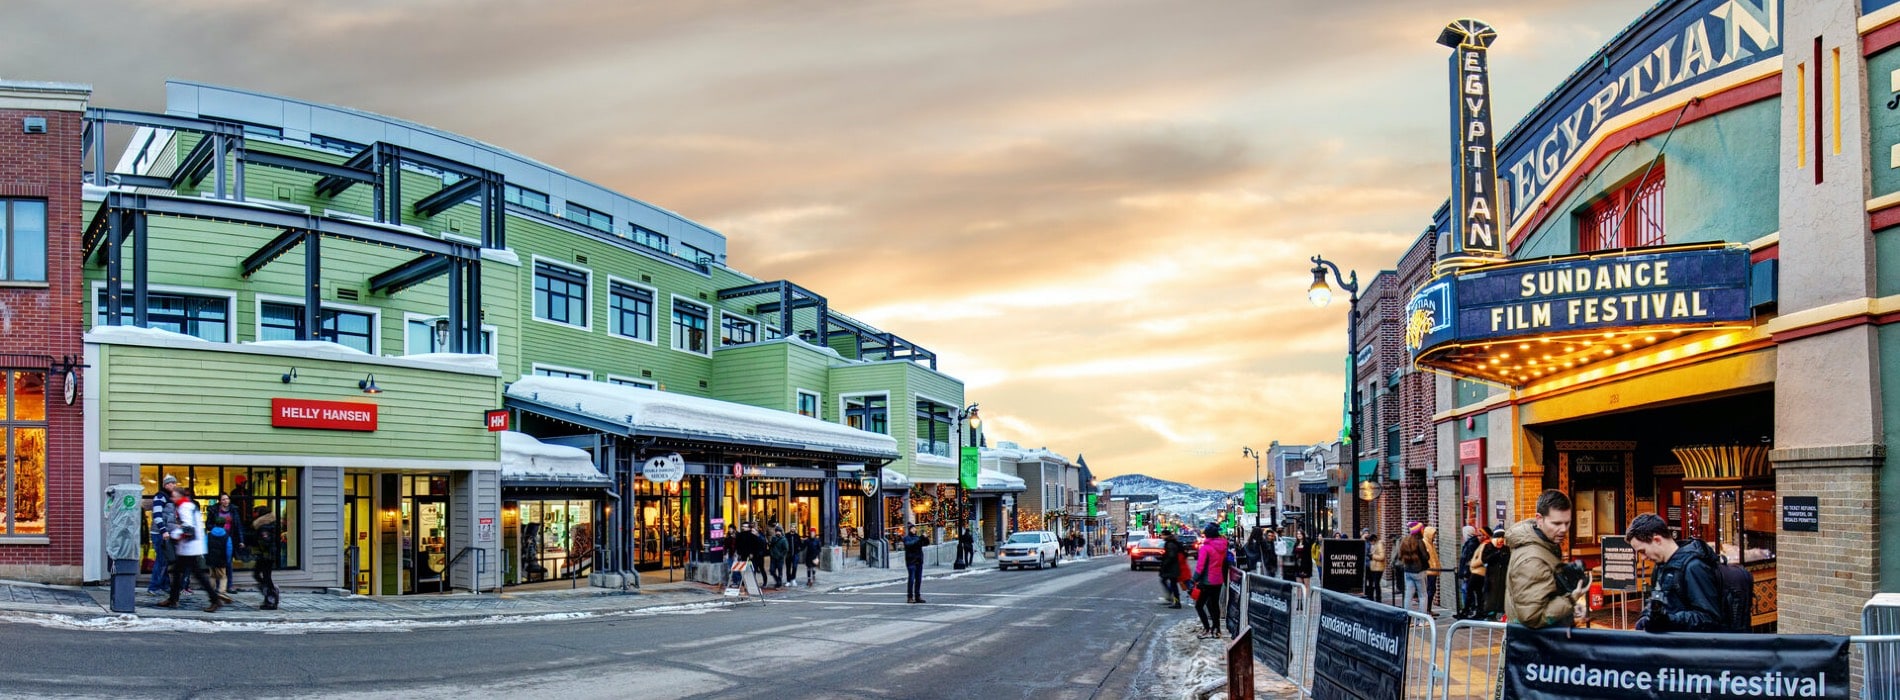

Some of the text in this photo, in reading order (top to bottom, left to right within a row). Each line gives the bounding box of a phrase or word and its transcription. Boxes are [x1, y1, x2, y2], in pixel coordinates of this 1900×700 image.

[1510, 0, 1778, 221] EGYPTIAN
[1465, 52, 1493, 246] EGYPTIAN
[1521, 261, 1669, 297] SUNDANCE
[1491, 291, 1707, 332] FILM FESTIVAL
[281, 406, 371, 422] HELLY HANSEN
[491, 415, 504, 427] HH
[1321, 614, 1399, 656] sundance film festival
[1525, 661, 1826, 697] sundance film festival
